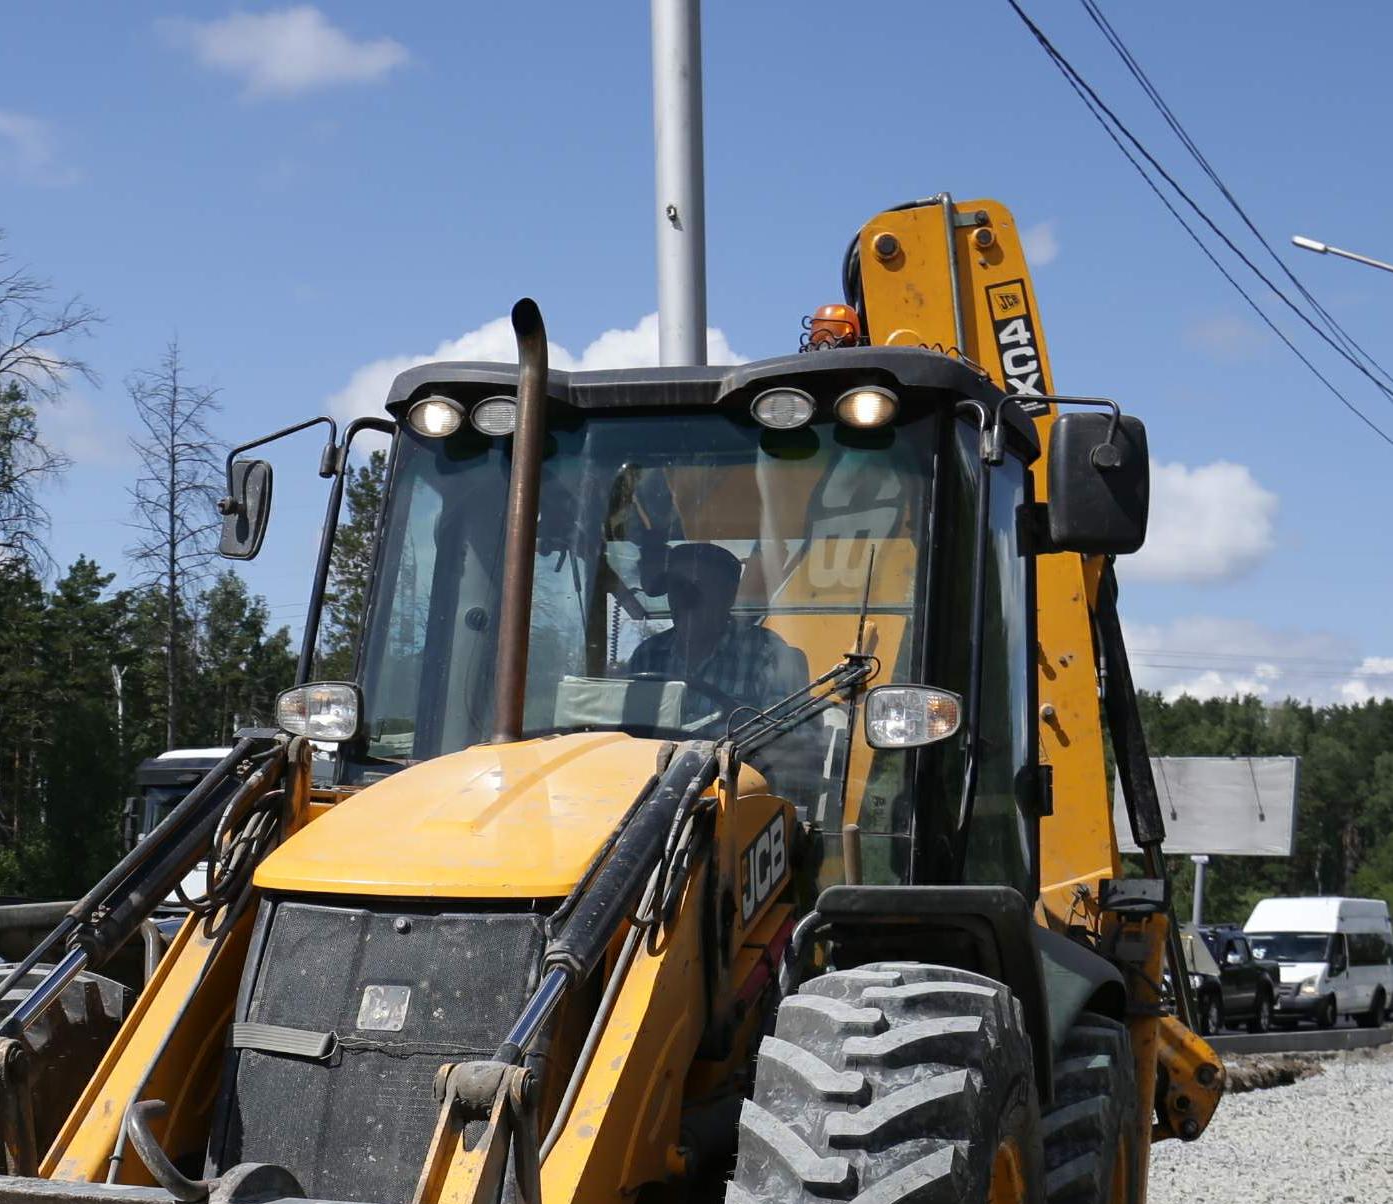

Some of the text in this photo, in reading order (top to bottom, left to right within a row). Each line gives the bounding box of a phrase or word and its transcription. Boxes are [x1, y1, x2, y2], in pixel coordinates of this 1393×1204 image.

[998, 293, 1020, 311] JCB
[998, 318, 1044, 404] 4CX
[742, 814, 785, 921] JCB
